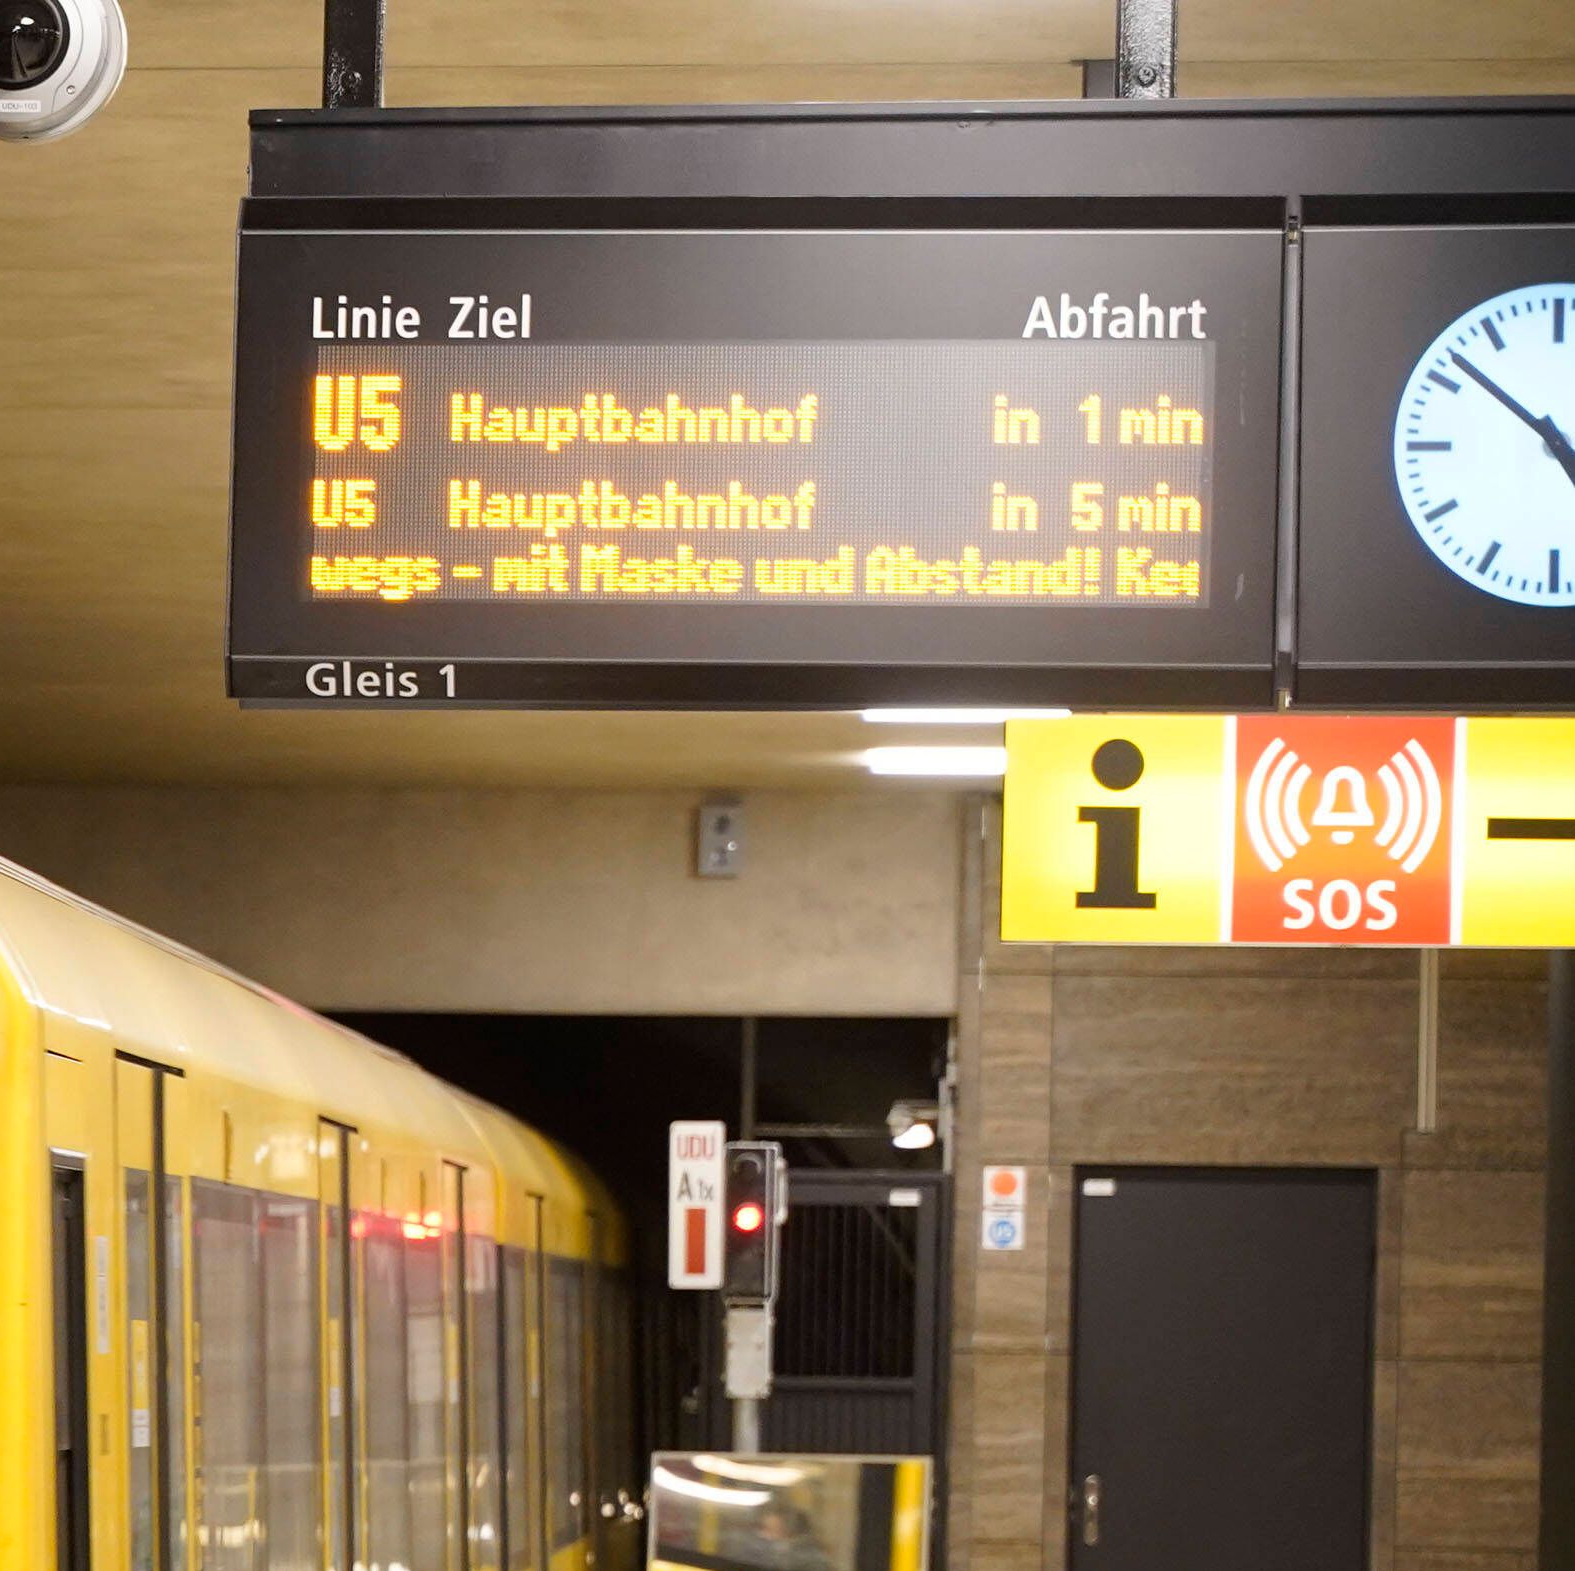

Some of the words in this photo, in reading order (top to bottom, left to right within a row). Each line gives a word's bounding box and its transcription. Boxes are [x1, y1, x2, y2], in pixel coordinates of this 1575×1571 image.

[312, 295, 420, 338] Linie
[448, 294, 531, 338] Ziel
[1022, 293, 1206, 338] Abfahrt
[313, 375, 402, 451] U5
[450, 393, 818, 452] Hauptbahnhof
[994, 394, 1040, 444] in
[1078, 393, 1101, 444] 1
[1120, 394, 1203, 444] min
[312, 479, 376, 527] U5
[449, 480, 816, 537] Hauptbahnhof
[992, 481, 1038, 531] in
[1072, 481, 1103, 531] 5
[1117, 481, 1202, 531] min
[311, 556, 441, 601] wegs
[493, 544, 569, 592] mit
[580, 544, 744, 593] Maske
[755, 545, 855, 594] und
[865, 545, 1101, 596] Abstand!
[305, 662, 419, 698] Gleis
[439, 664, 457, 698] 1
[1282, 878, 1398, 931] SOS
[677, 1135, 715, 1160] UDU
